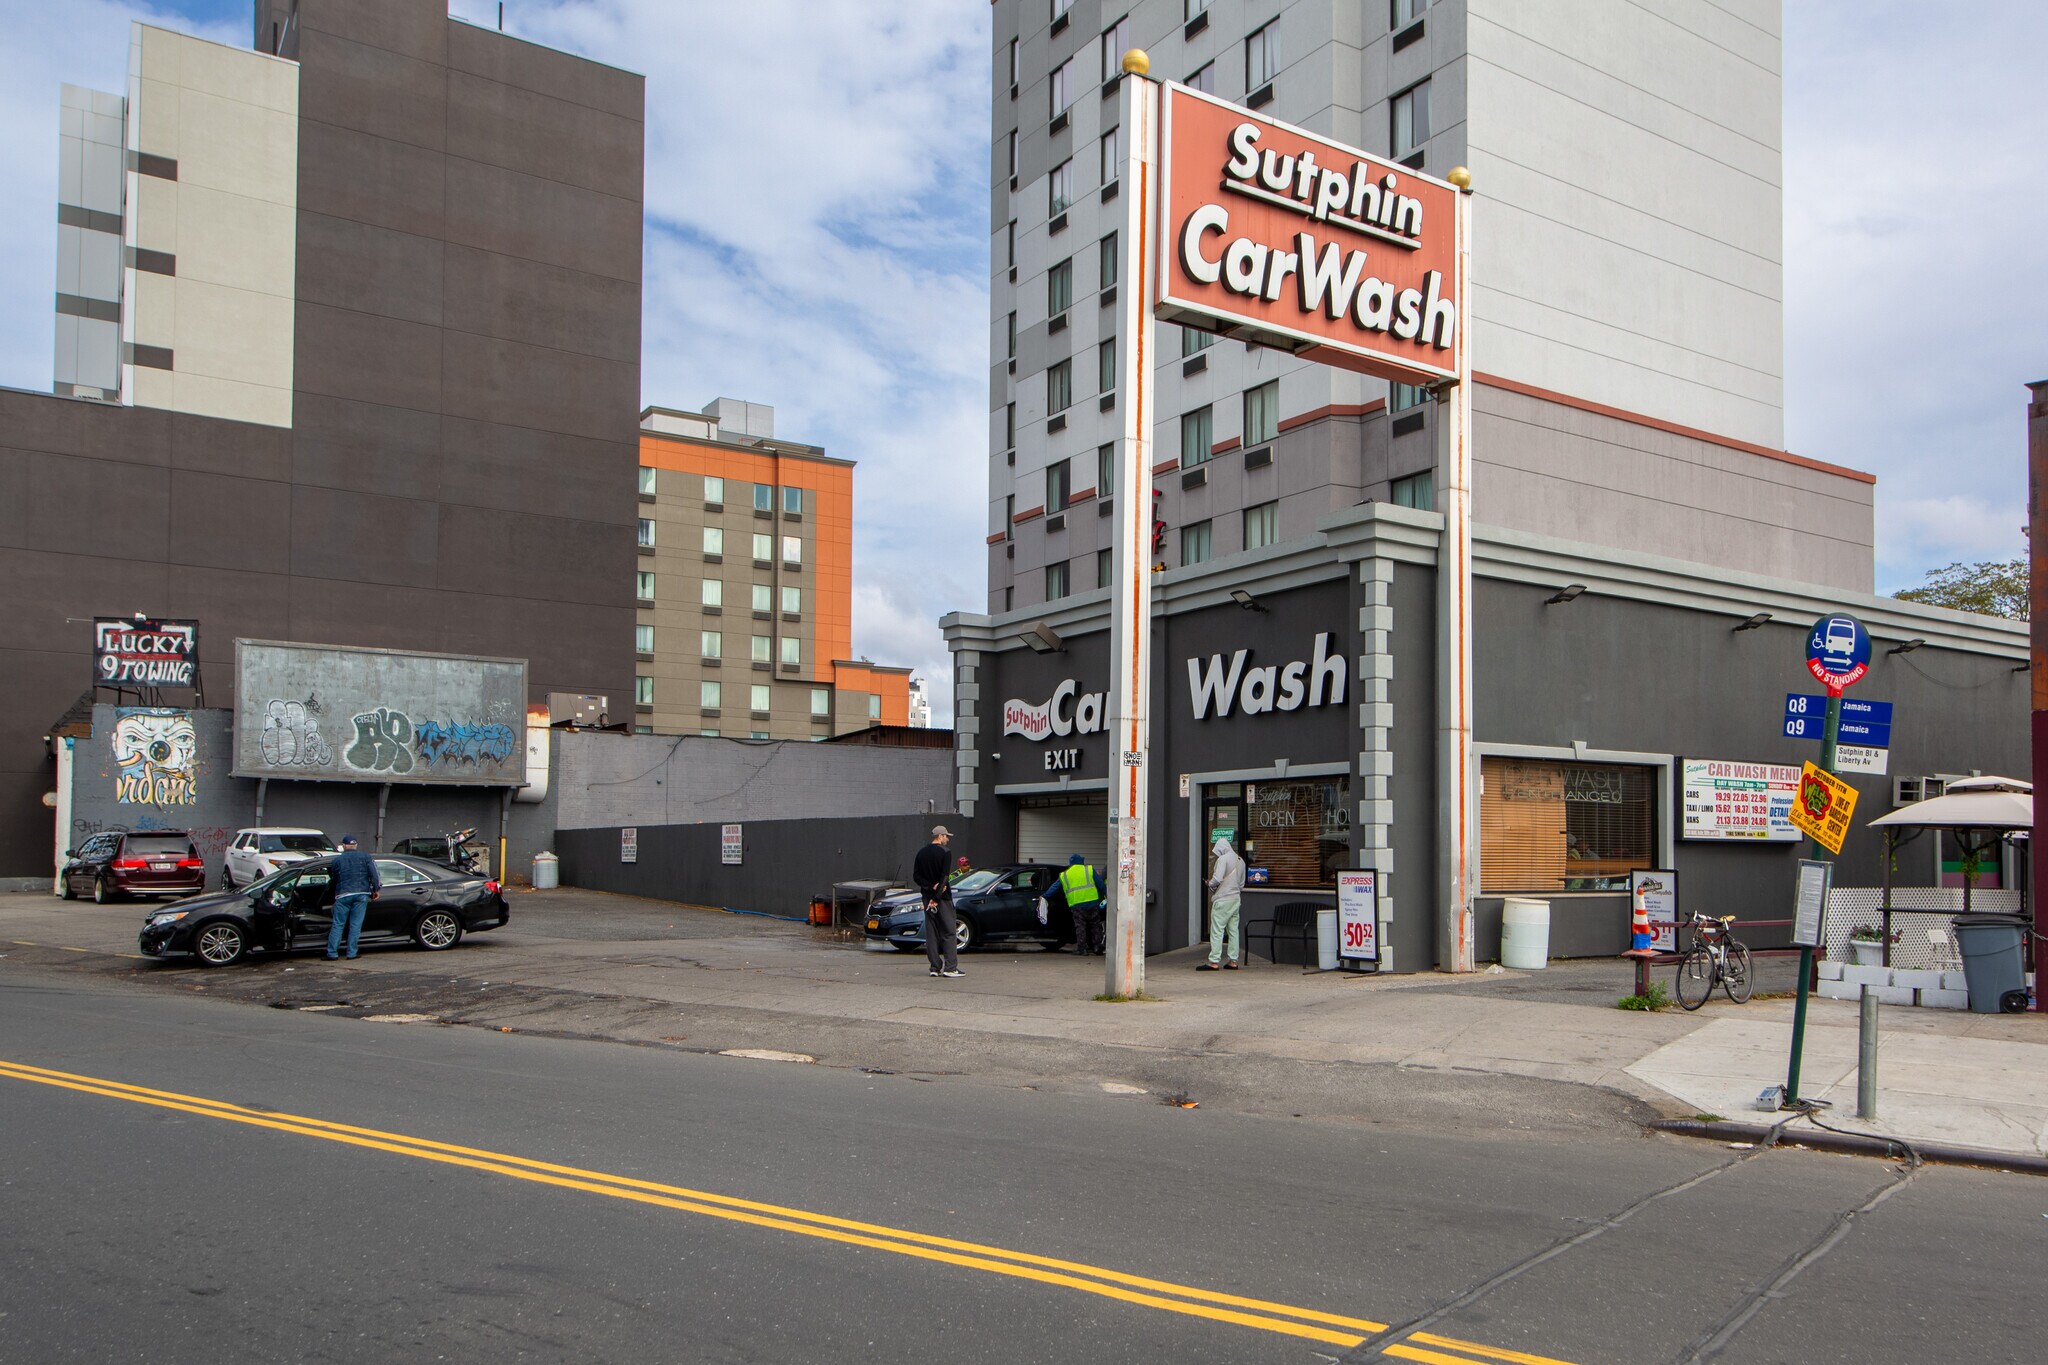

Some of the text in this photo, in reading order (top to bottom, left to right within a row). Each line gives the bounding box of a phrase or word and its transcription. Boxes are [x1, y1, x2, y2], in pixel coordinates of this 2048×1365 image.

[1222, 122, 1423, 238] Sutphin
[104, 634, 183, 654] LUCKY
[102, 655, 193, 684] 9 TOWING
[1187, 632, 1348, 720] Wash
[1811, 663, 1864, 685] NO STANDING
[1788, 697, 1807, 713] Q8
[1842, 701, 1872, 712] Jamaica
[1005, 705, 1047, 734] Sutphin
[1786, 719, 1805, 735] Q9
[1840, 724, 1869, 734] Jamaica
[1044, 749, 1080, 771] EXIT
[1838, 747, 1864, 757] Sutphin
[1837, 757, 1861, 767] Liberty
[1708, 763, 1731, 777] CAR
[1734, 765, 1767, 780] WASH
[1770, 767, 1800, 782] MENU
[1814, 770, 1836, 788] OCTOBER
[1835, 784, 1847, 794] 11TH
[1715, 793, 1731, 802] 19.29
[1732, 793, 1748, 802] 22.05
[1750, 794, 1766, 803] 22.96
[1715, 804, 1731, 813] 15.62
[1734, 805, 1748, 814] 18.37
[1752, 806, 1766, 814] 19.29
[1770, 807, 1792, 818] DETAIL
[1828, 806, 1848, 826] BARCLAYS
[1259, 810, 1295, 826] OPEN
[1716, 816, 1731, 824] 21.13
[1732, 816, 1748, 825] 23.88
[1750, 817, 1766, 826] 24.80
[1826, 820, 1842, 836] CENTER
